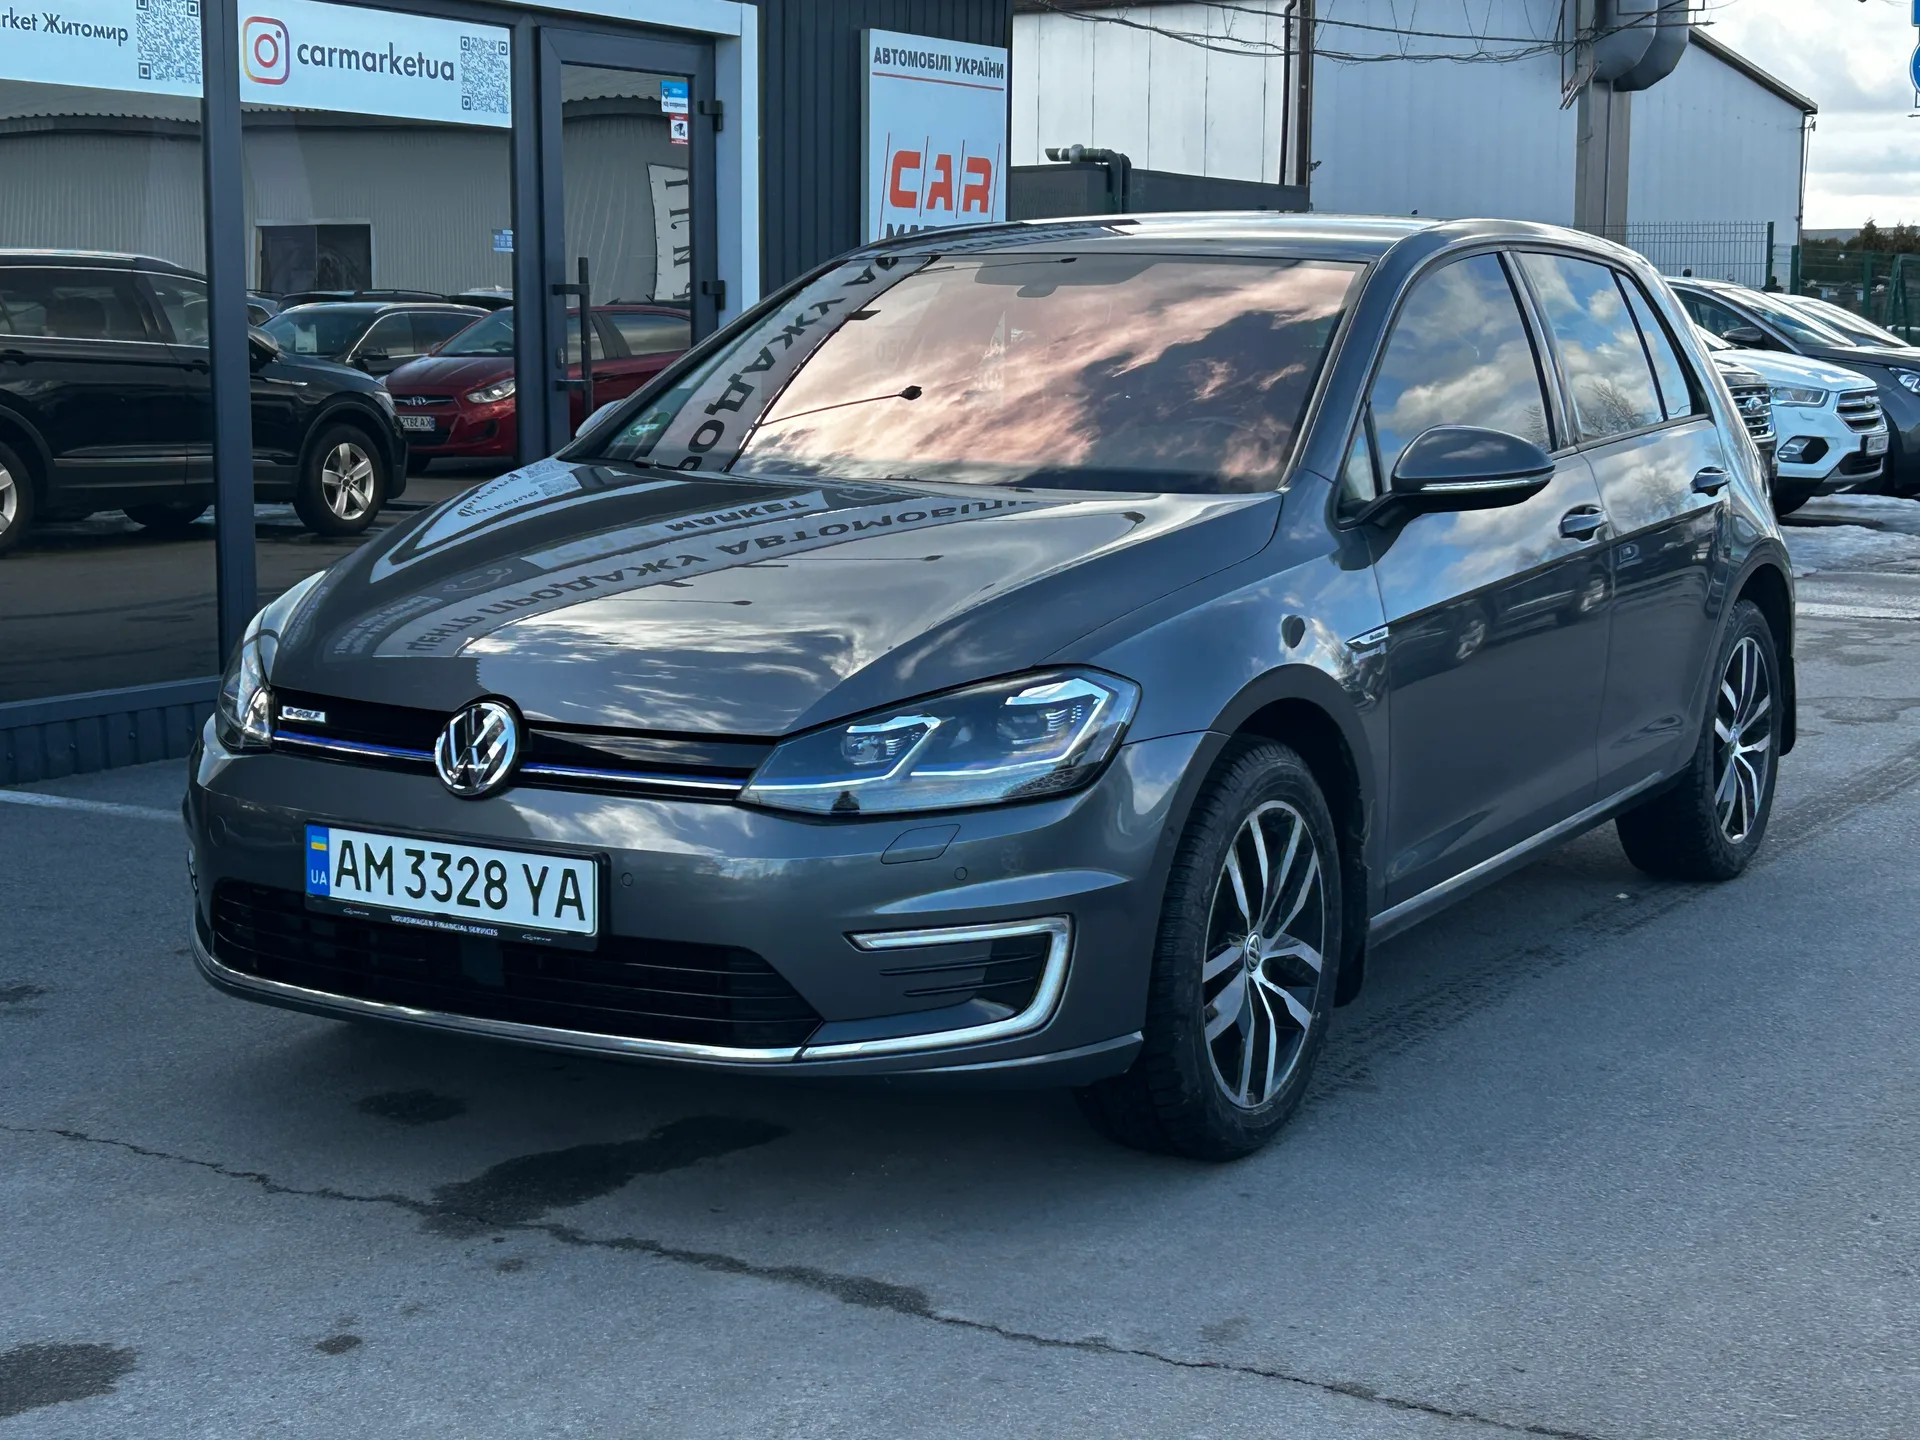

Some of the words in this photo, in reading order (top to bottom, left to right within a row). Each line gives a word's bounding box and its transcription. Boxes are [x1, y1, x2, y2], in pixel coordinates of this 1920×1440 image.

[0, 6, 38, 31] rket
[42, 12, 129, 46] Житомир
[297, 42, 455, 80] carmarketua
[873, 46, 951, 72] АВТОМОБІЛІ
[955, 56, 1005, 79] УКРАЇНИ
[889, 150, 992, 213] CAR
[311, 869, 327, 885] UA
[335, 840, 394, 895] AM
[404, 848, 508, 910] 3328
[522, 863, 586, 921] YA
[391, 915, 433, 927] VOLKSWAGEN
[434, 920, 468, 932] FINANCIAL
[469, 925, 498, 936] SERVICES
